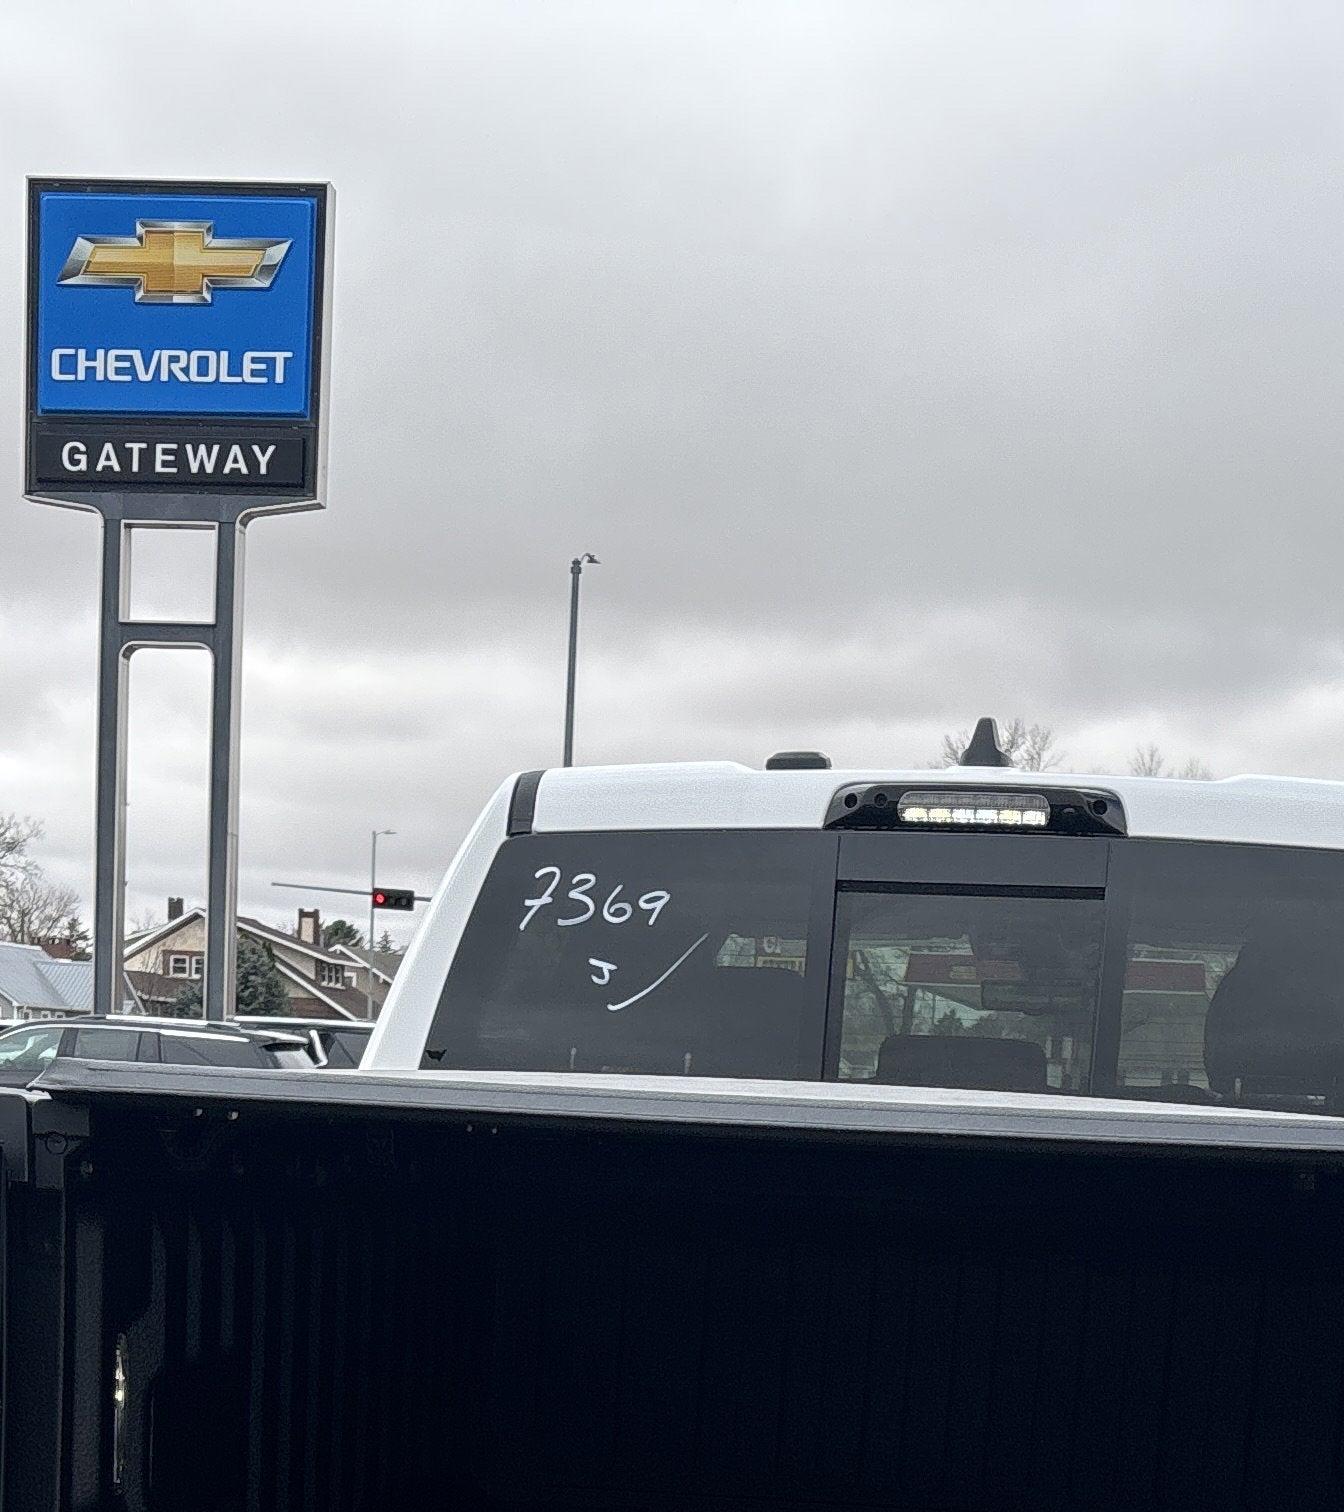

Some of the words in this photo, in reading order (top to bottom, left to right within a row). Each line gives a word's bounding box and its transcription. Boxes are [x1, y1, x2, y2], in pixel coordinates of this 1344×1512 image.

[51, 348, 293, 384] CHEVROLET
[61, 441, 277, 475] GATEWAY
[519, 866, 671, 931] 7369
